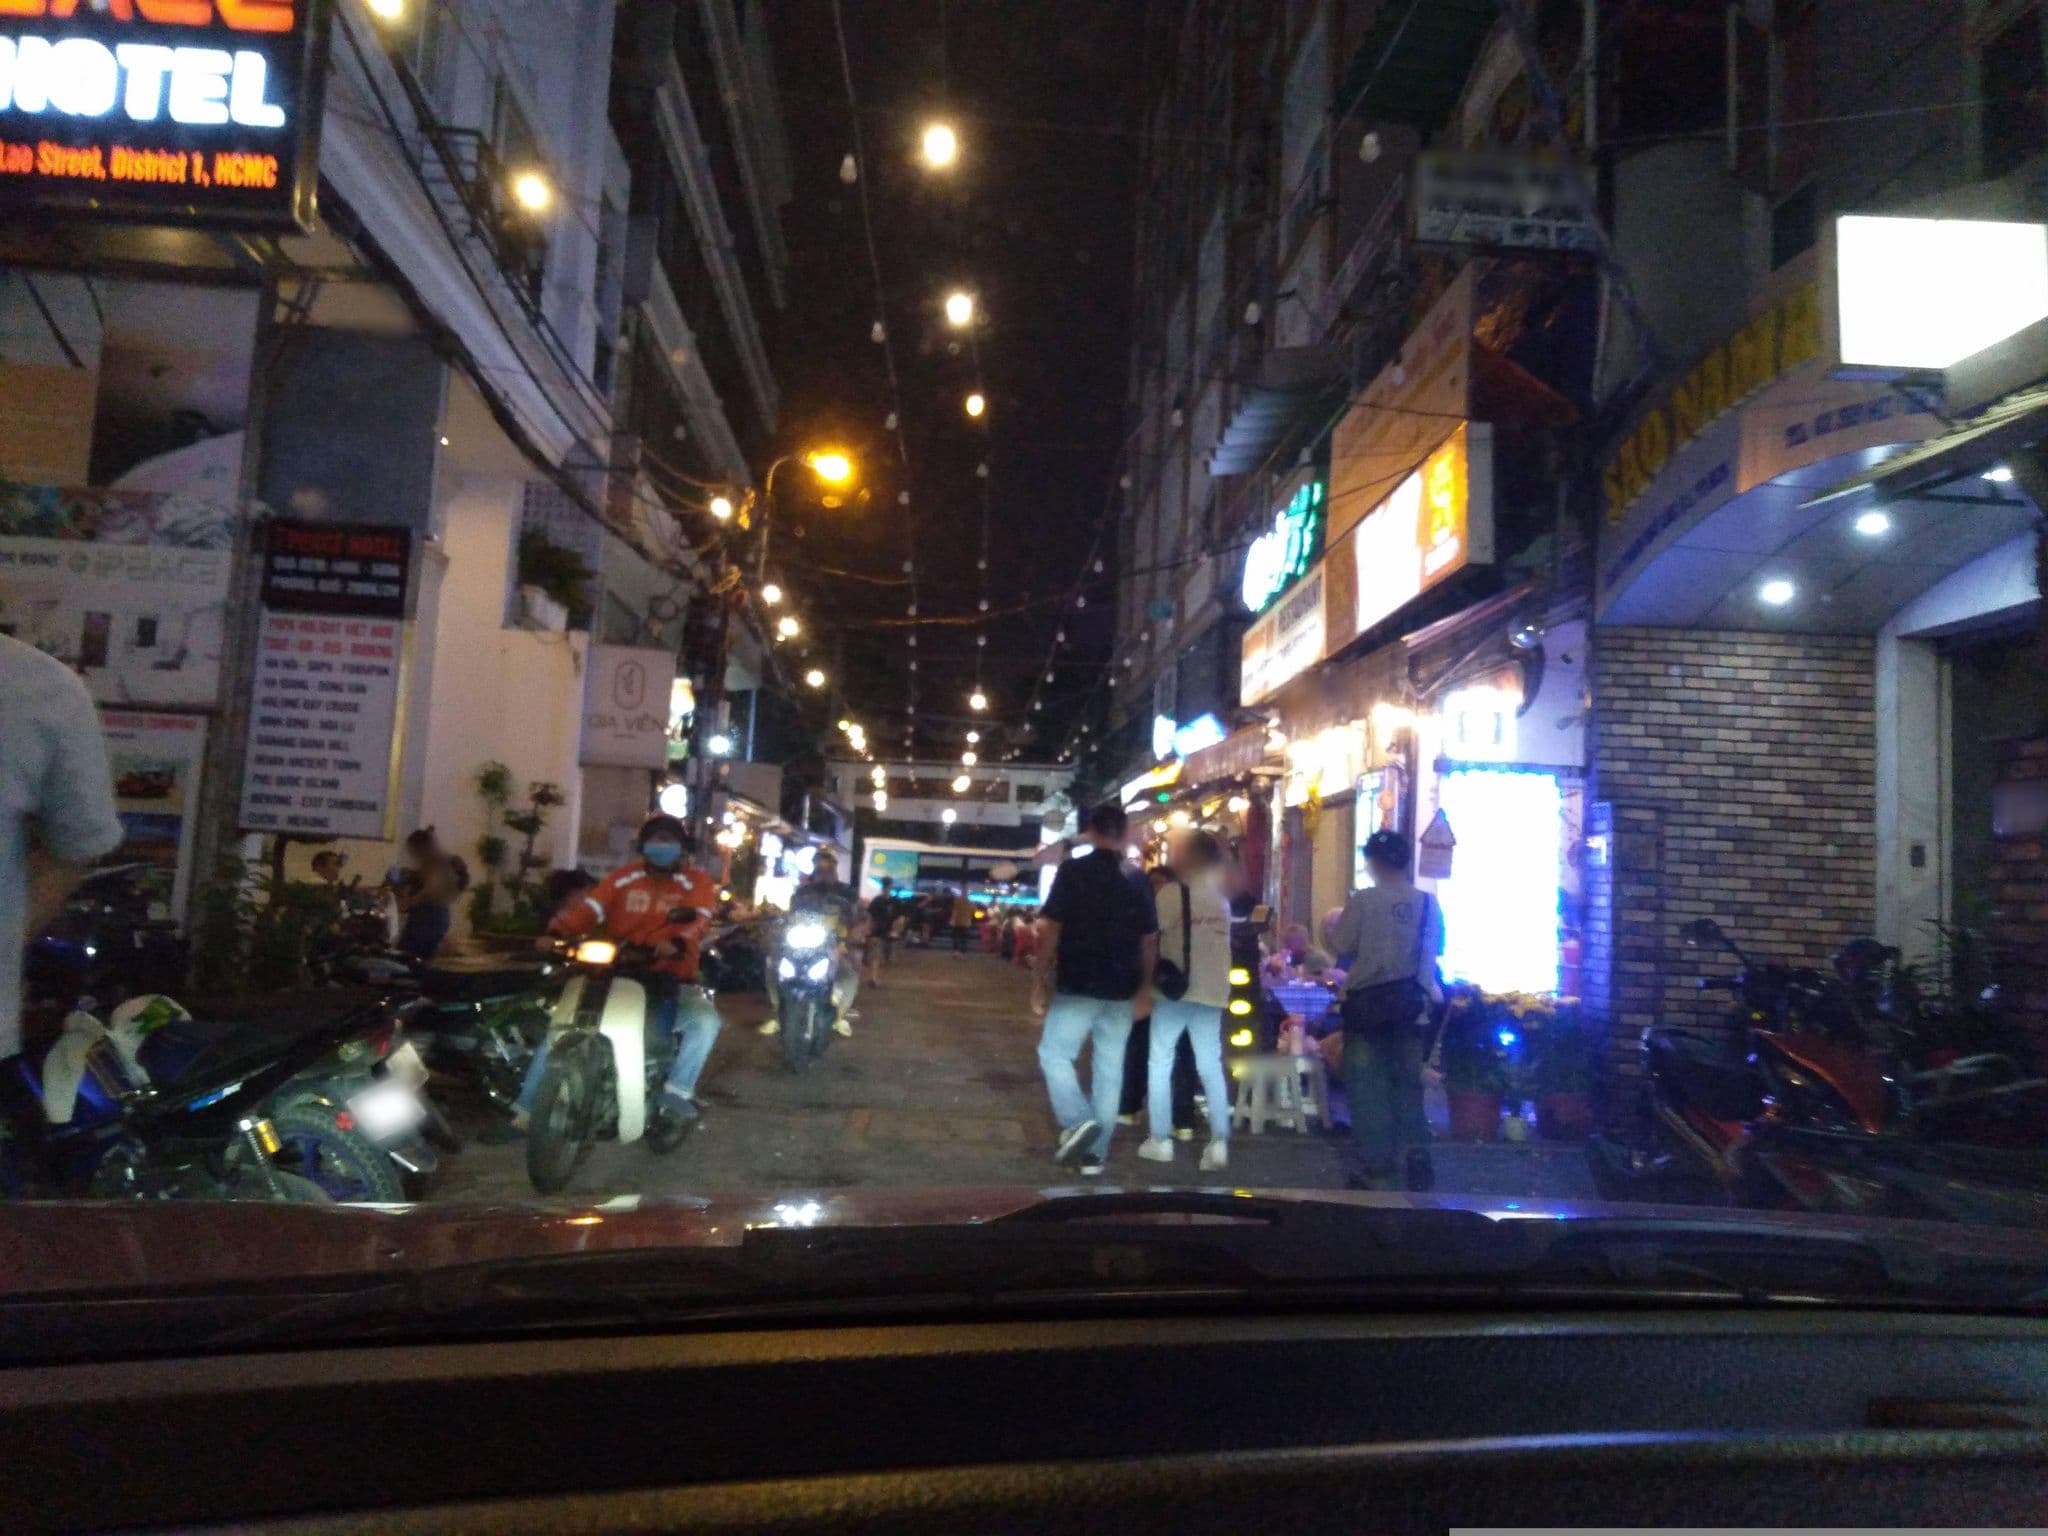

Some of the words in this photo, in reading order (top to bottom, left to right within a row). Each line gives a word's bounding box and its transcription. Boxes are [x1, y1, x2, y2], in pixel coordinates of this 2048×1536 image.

[0, 36, 286, 128] HOTEL
[37, 141, 106, 182] Street,
[109, 145, 188, 184] District
[214, 152, 279, 188] HCMC
